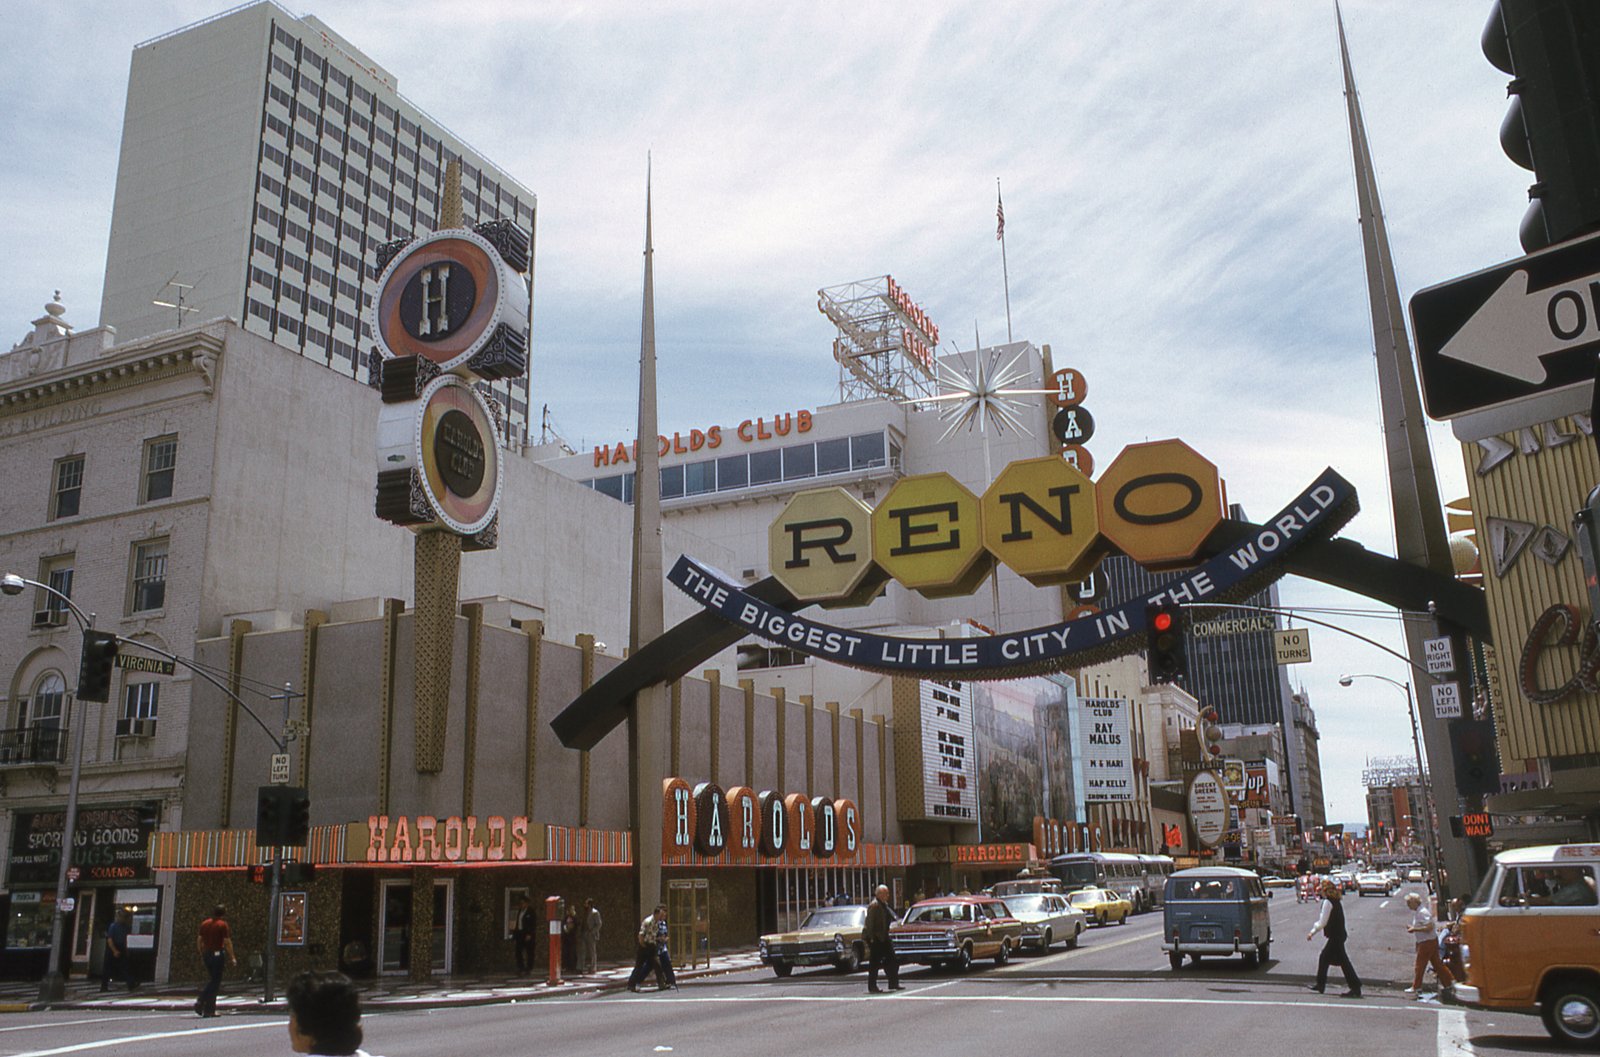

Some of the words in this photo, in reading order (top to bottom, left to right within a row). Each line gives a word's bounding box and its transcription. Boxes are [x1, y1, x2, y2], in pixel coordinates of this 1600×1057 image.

[418, 264, 451, 336] H
[886, 274, 940, 345] HAROLDS
[1547, 279, 1600, 341] O
[902, 327, 932, 368] CLUB
[593, 425, 722, 467] HAOLDS
[737, 409, 813, 442] CLUB
[784, 472, 1204, 570] RENO
[682, 566, 729, 609] THE
[740, 602, 862, 657] BIGGEST
[881, 642, 979, 665] LITTLE
[1001, 626, 1072, 660] CITY
[1095, 609, 1130, 639] IN
[1228, 484, 1336, 571] WORLD
[1193, 617, 1265, 637] COMMERCIAL
[1283, 635, 1300, 646] NO
[1430, 642, 1445, 652] NO
[1278, 648, 1308, 660] TURNS
[1427, 652, 1451, 661] RIGHT
[120, 655, 163, 673] VIRGINIA
[1429, 661, 1452, 670] TURN
[1437, 687, 1453, 697] NO
[1085, 700, 1120, 709] HAROLDS
[1436, 697, 1456, 706] LEFT
[1093, 709, 1113, 717] CLUB
[1436, 706, 1460, 715] TURN
[1094, 722, 1114, 734] RAY
[1089, 734, 1122, 745] MALUS
[276, 756, 287, 765] NO
[1090, 759, 1097, 768] M
[1106, 760, 1124, 768] HARI
[273, 765, 289, 773] LEFT
[1089, 779, 1104, 788] HAP
[1106, 780, 1127, 788] KELLY
[675, 787, 856, 852] HAROLDS
[1463, 814, 1489, 825] DONT
[92, 827, 140, 845] GOODS
[1465, 825, 1492, 837] WALK
[367, 815, 528, 862] HAROLDS
[50, 846, 114, 866] DUGS
[957, 844, 1023, 863] HAROLDS
[91, 867, 136, 878] SOUVENIRS
